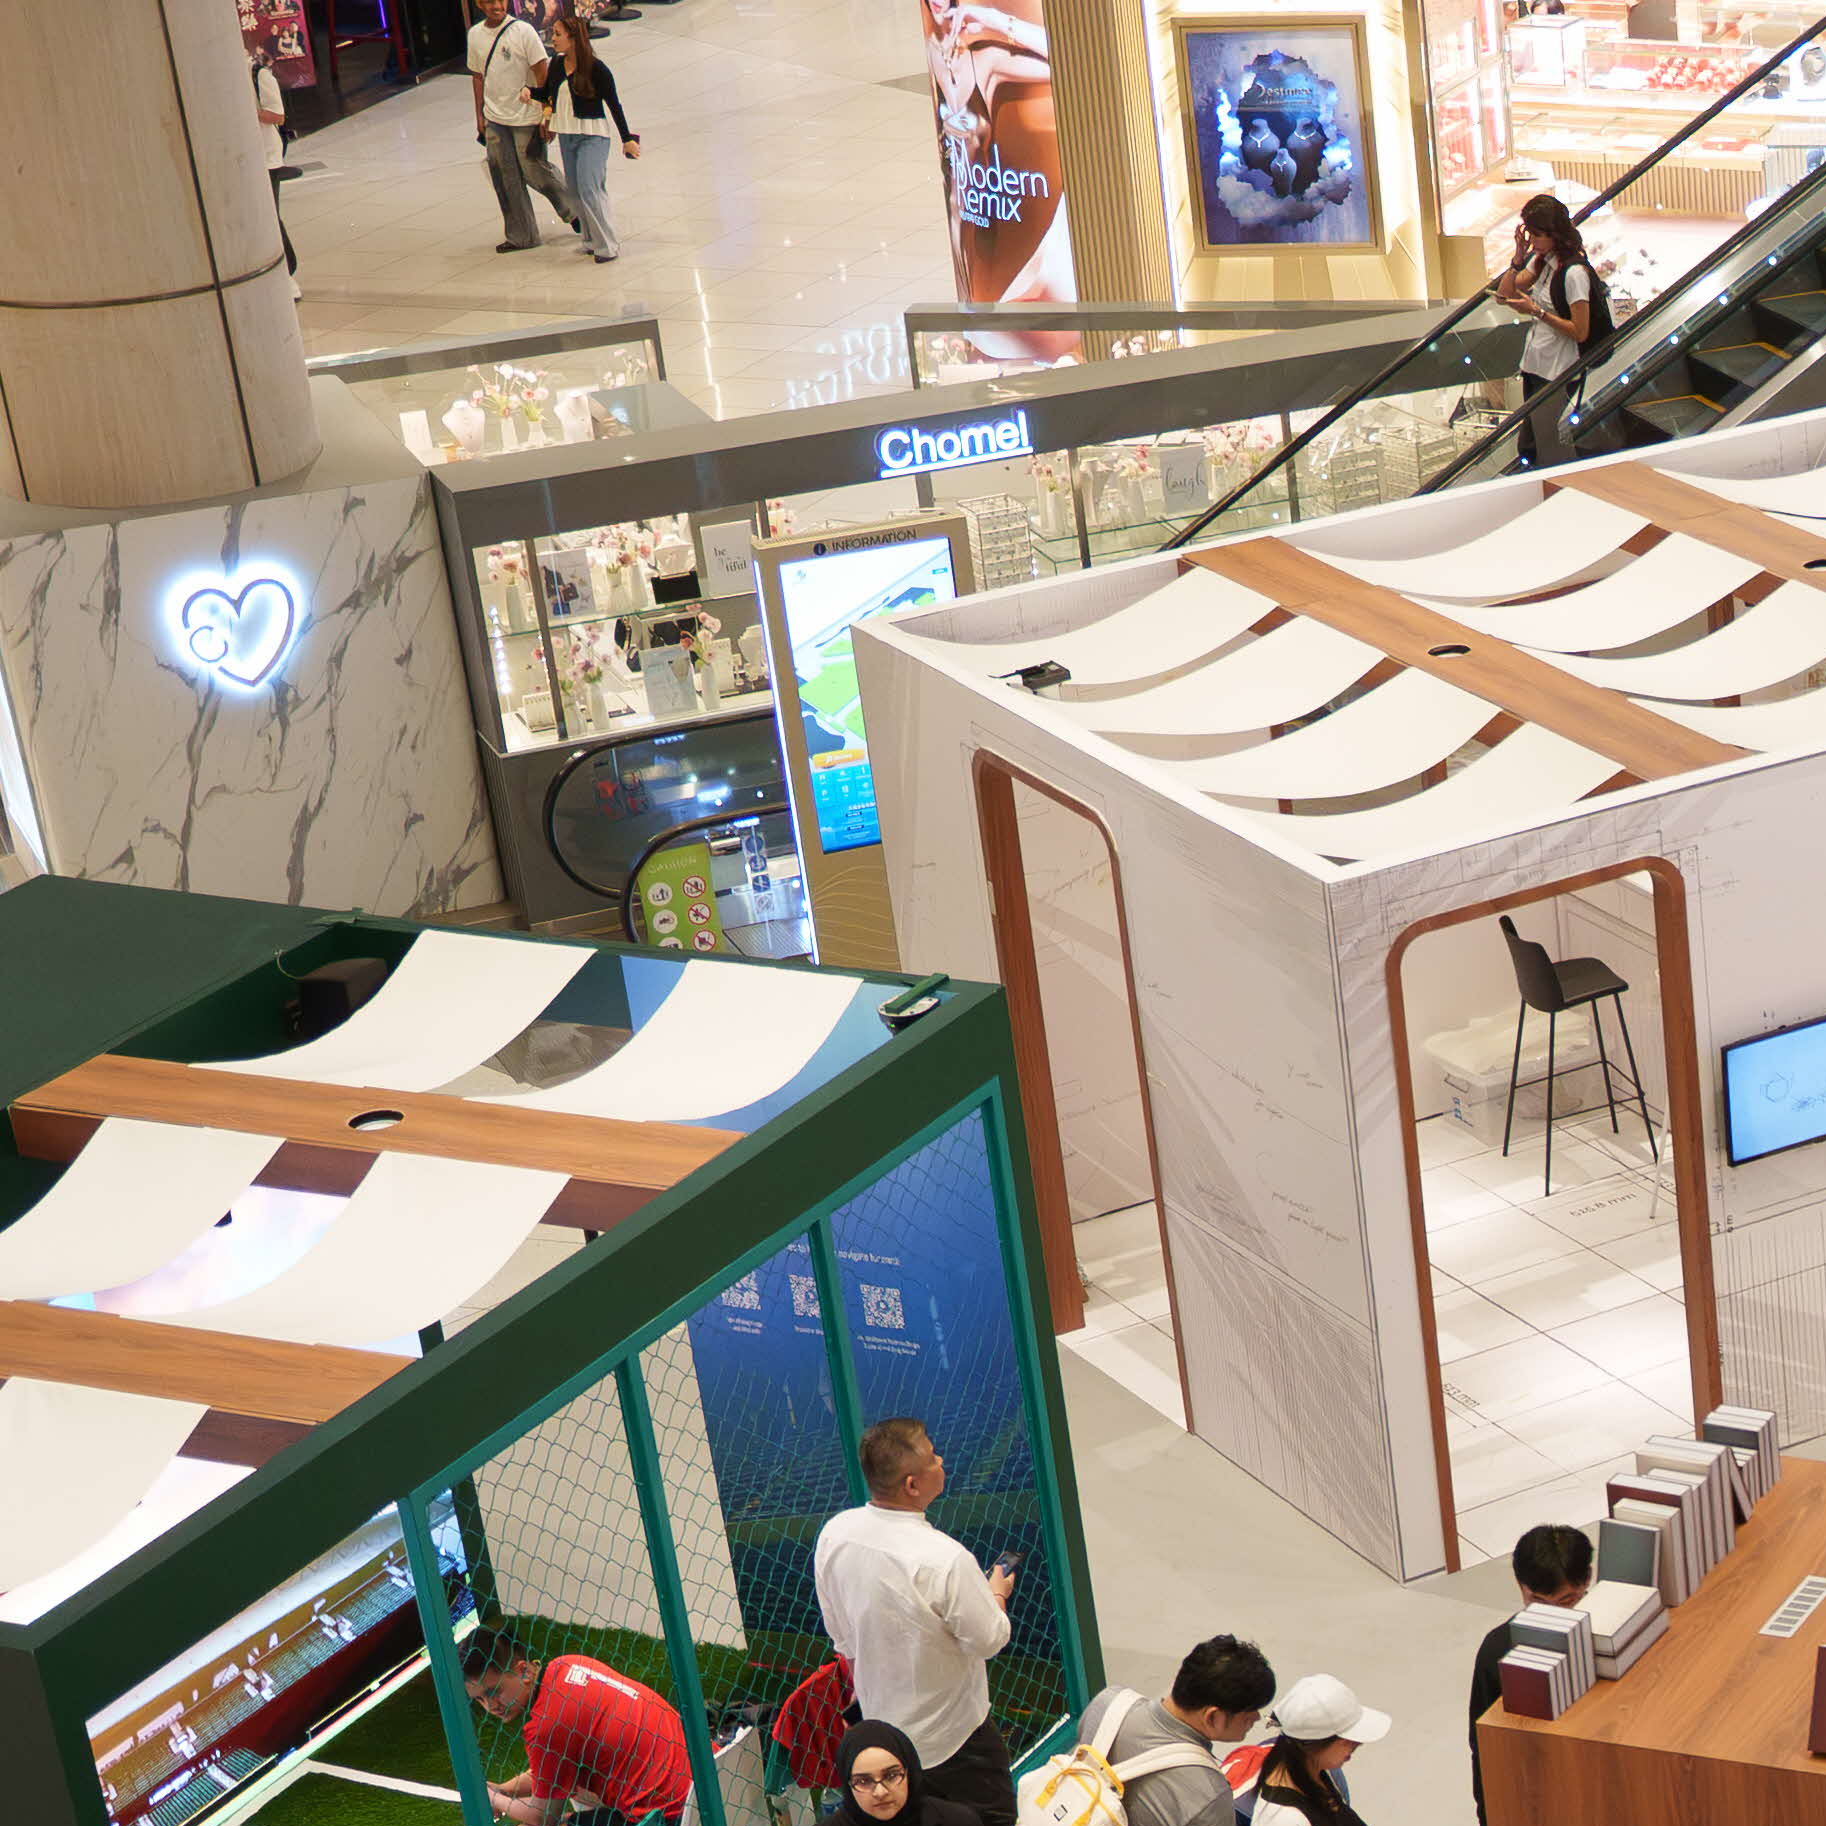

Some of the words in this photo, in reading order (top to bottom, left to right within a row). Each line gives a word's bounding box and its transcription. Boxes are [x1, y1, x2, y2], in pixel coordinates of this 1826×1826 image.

[945, 136, 1048, 198] Modern
[957, 162, 1022, 223] Remix
[880, 411, 1029, 469] Chomel
[832, 528, 917, 552] INFORMATION
